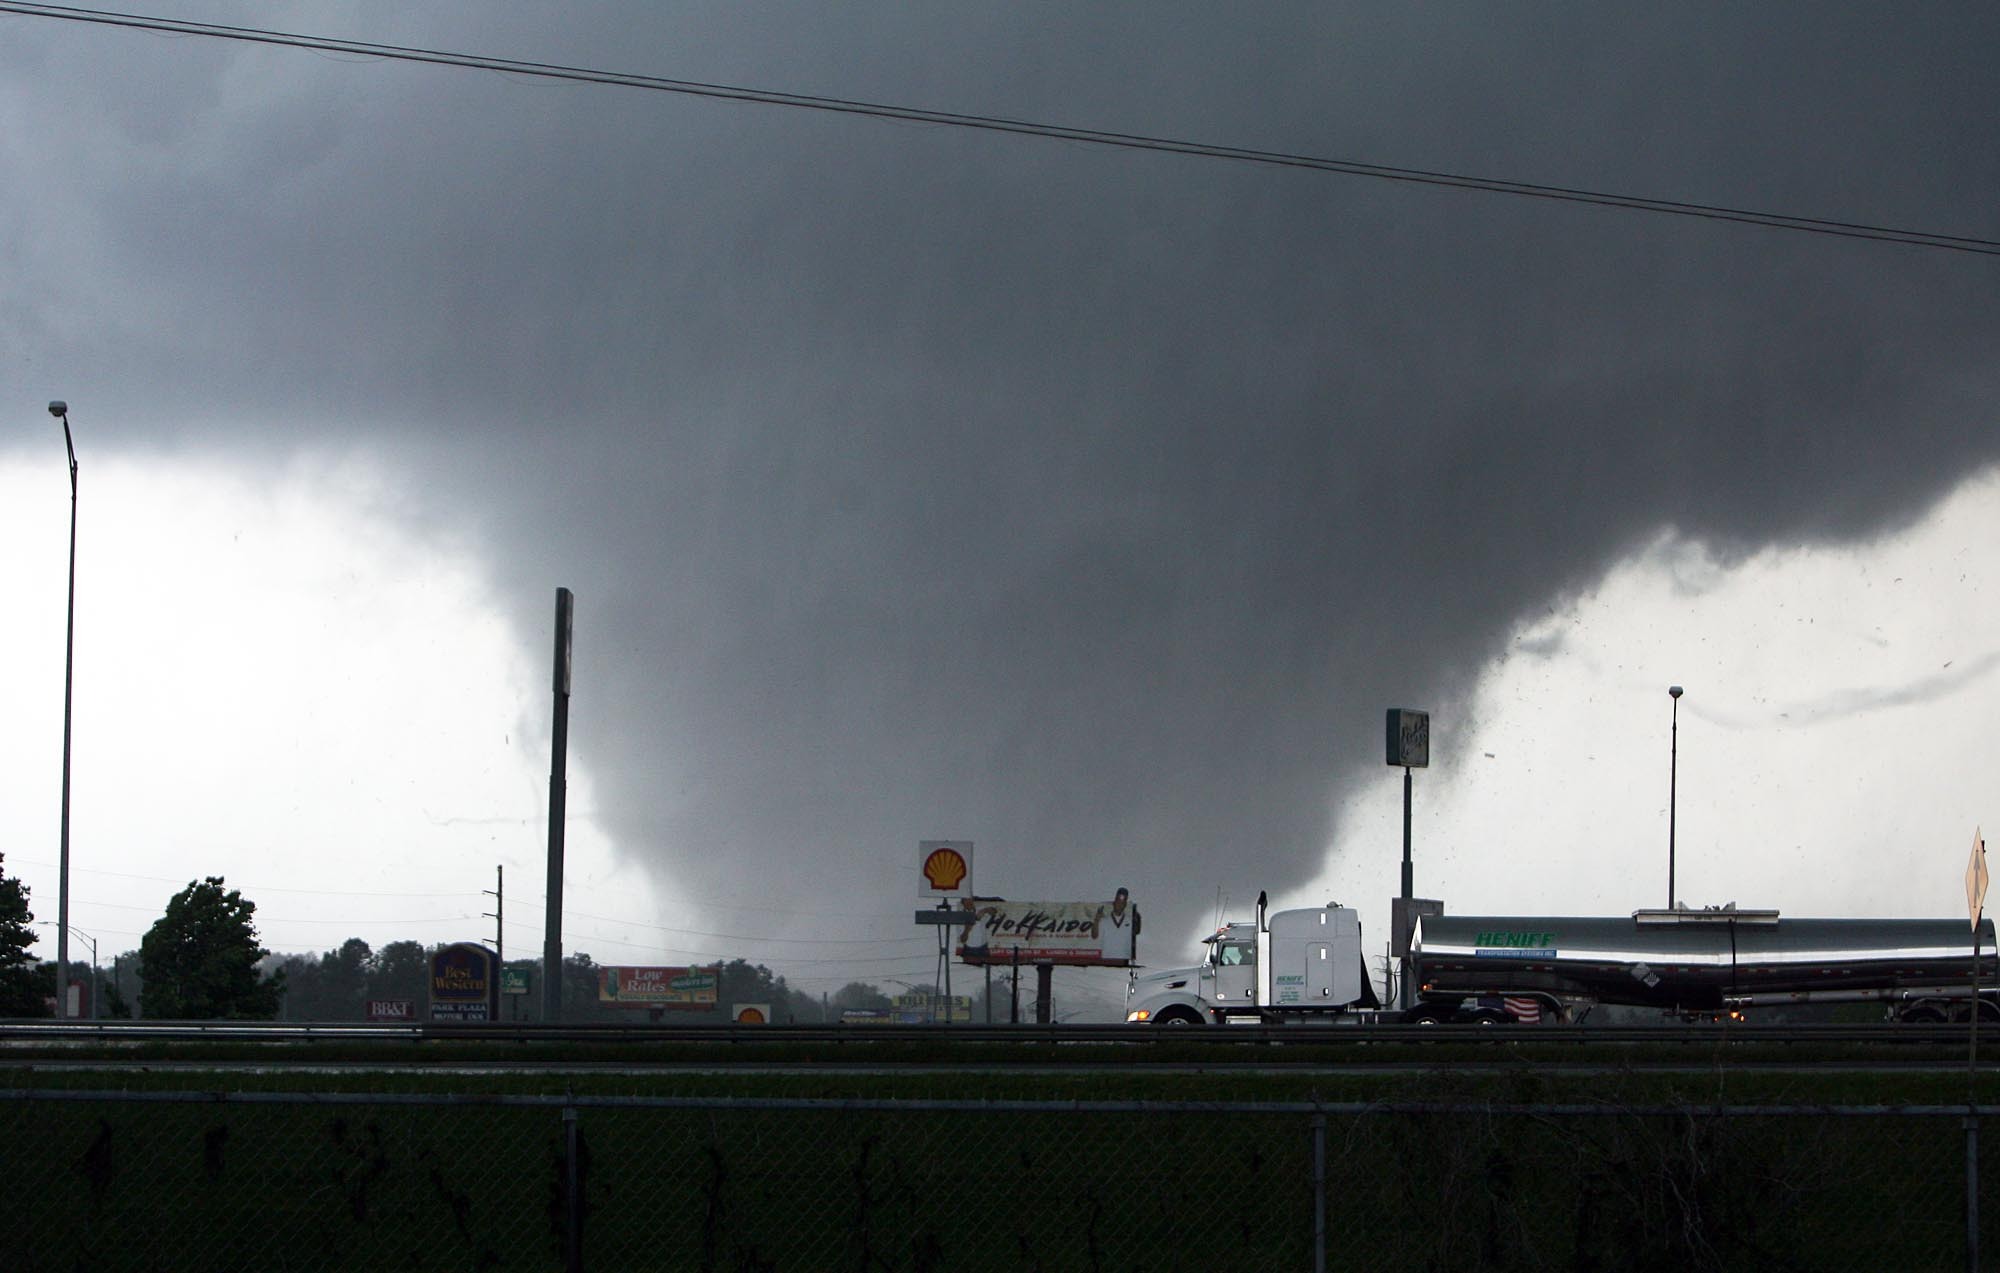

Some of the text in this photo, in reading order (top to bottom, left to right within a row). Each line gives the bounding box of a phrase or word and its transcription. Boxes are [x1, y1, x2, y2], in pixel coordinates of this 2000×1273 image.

[1475, 932, 1555, 947] HENIFF
[446, 966, 471, 978] Best
[635, 968, 662, 980] Low
[435, 977, 484, 990] Western
[627, 980, 666, 992] Rates
[372, 1001, 409, 1016] BB&T
